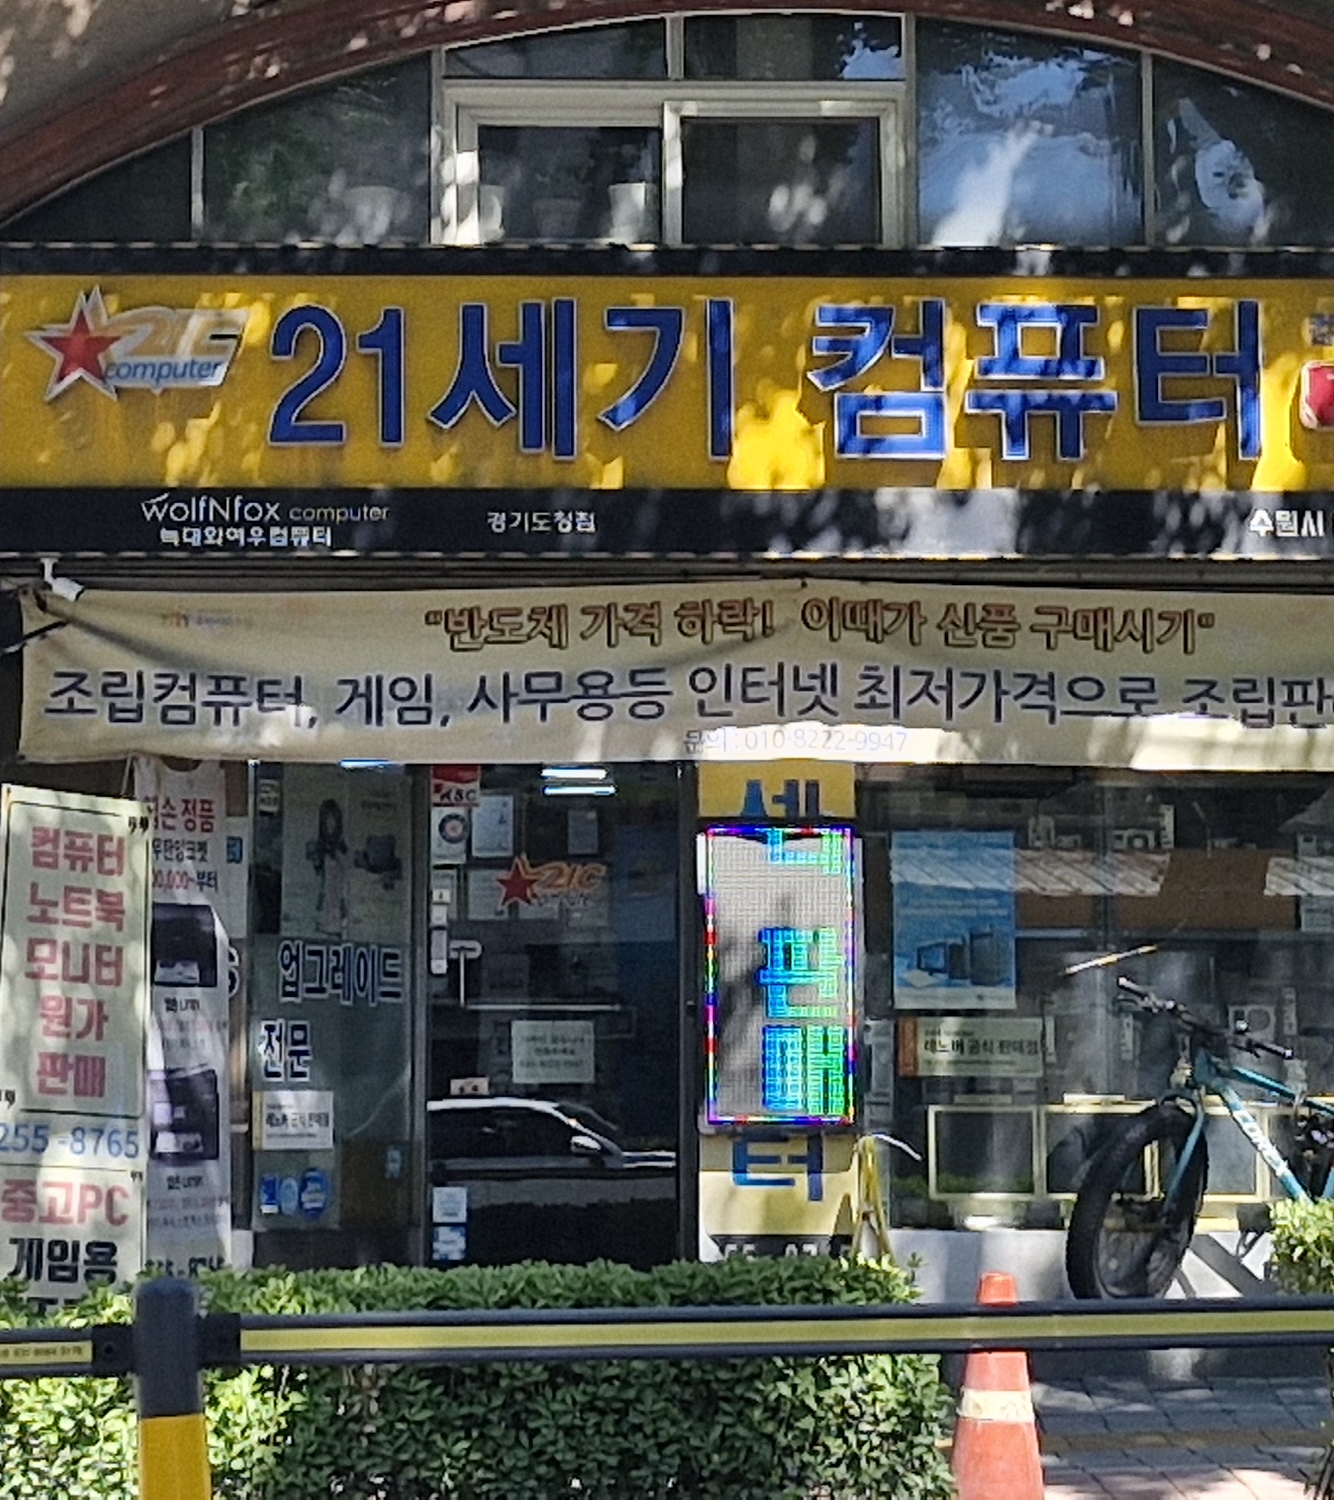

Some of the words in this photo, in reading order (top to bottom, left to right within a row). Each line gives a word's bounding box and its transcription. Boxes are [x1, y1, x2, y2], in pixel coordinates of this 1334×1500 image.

[105, 358, 223, 383] computer
[268, 297, 735, 461] 21세기
[806, 297, 1264, 461] 컴퓨터
[160, 526, 332, 547] 늑대와여우컴퓨터
[289, 503, 390, 526] computer
[486, 510, 597, 535] 경기도청점
[1250, 510, 1324, 538] 수원시
[580, 601, 663, 647] 가격
[673, 599, 776, 643] 하락!
[800, 596, 927, 645] 이때가
[936, 601, 1021, 649] 신품
[43, 669, 318, 730] 조립컴퓨터,
[334, 673, 451, 729] 게임,
[466, 667, 674, 723] 사무용등
[687, 661, 840, 719] 인터넷
[854, 663, 1165, 725] 최저가격으로
[30, 824, 127, 877] 컴퓨터
[26, 880, 126, 932] 노트북
[24, 936, 125, 988] 모니터
[279, 940, 403, 1007] 업그레이드
[39, 996, 110, 1042] 원가
[261, 1018, 313, 1082] 전문
[36, 1051, 108, 1100] 판매
[0, 1178, 131, 1227] 중고PC
[7, 1237, 118, 1286] 게임용
